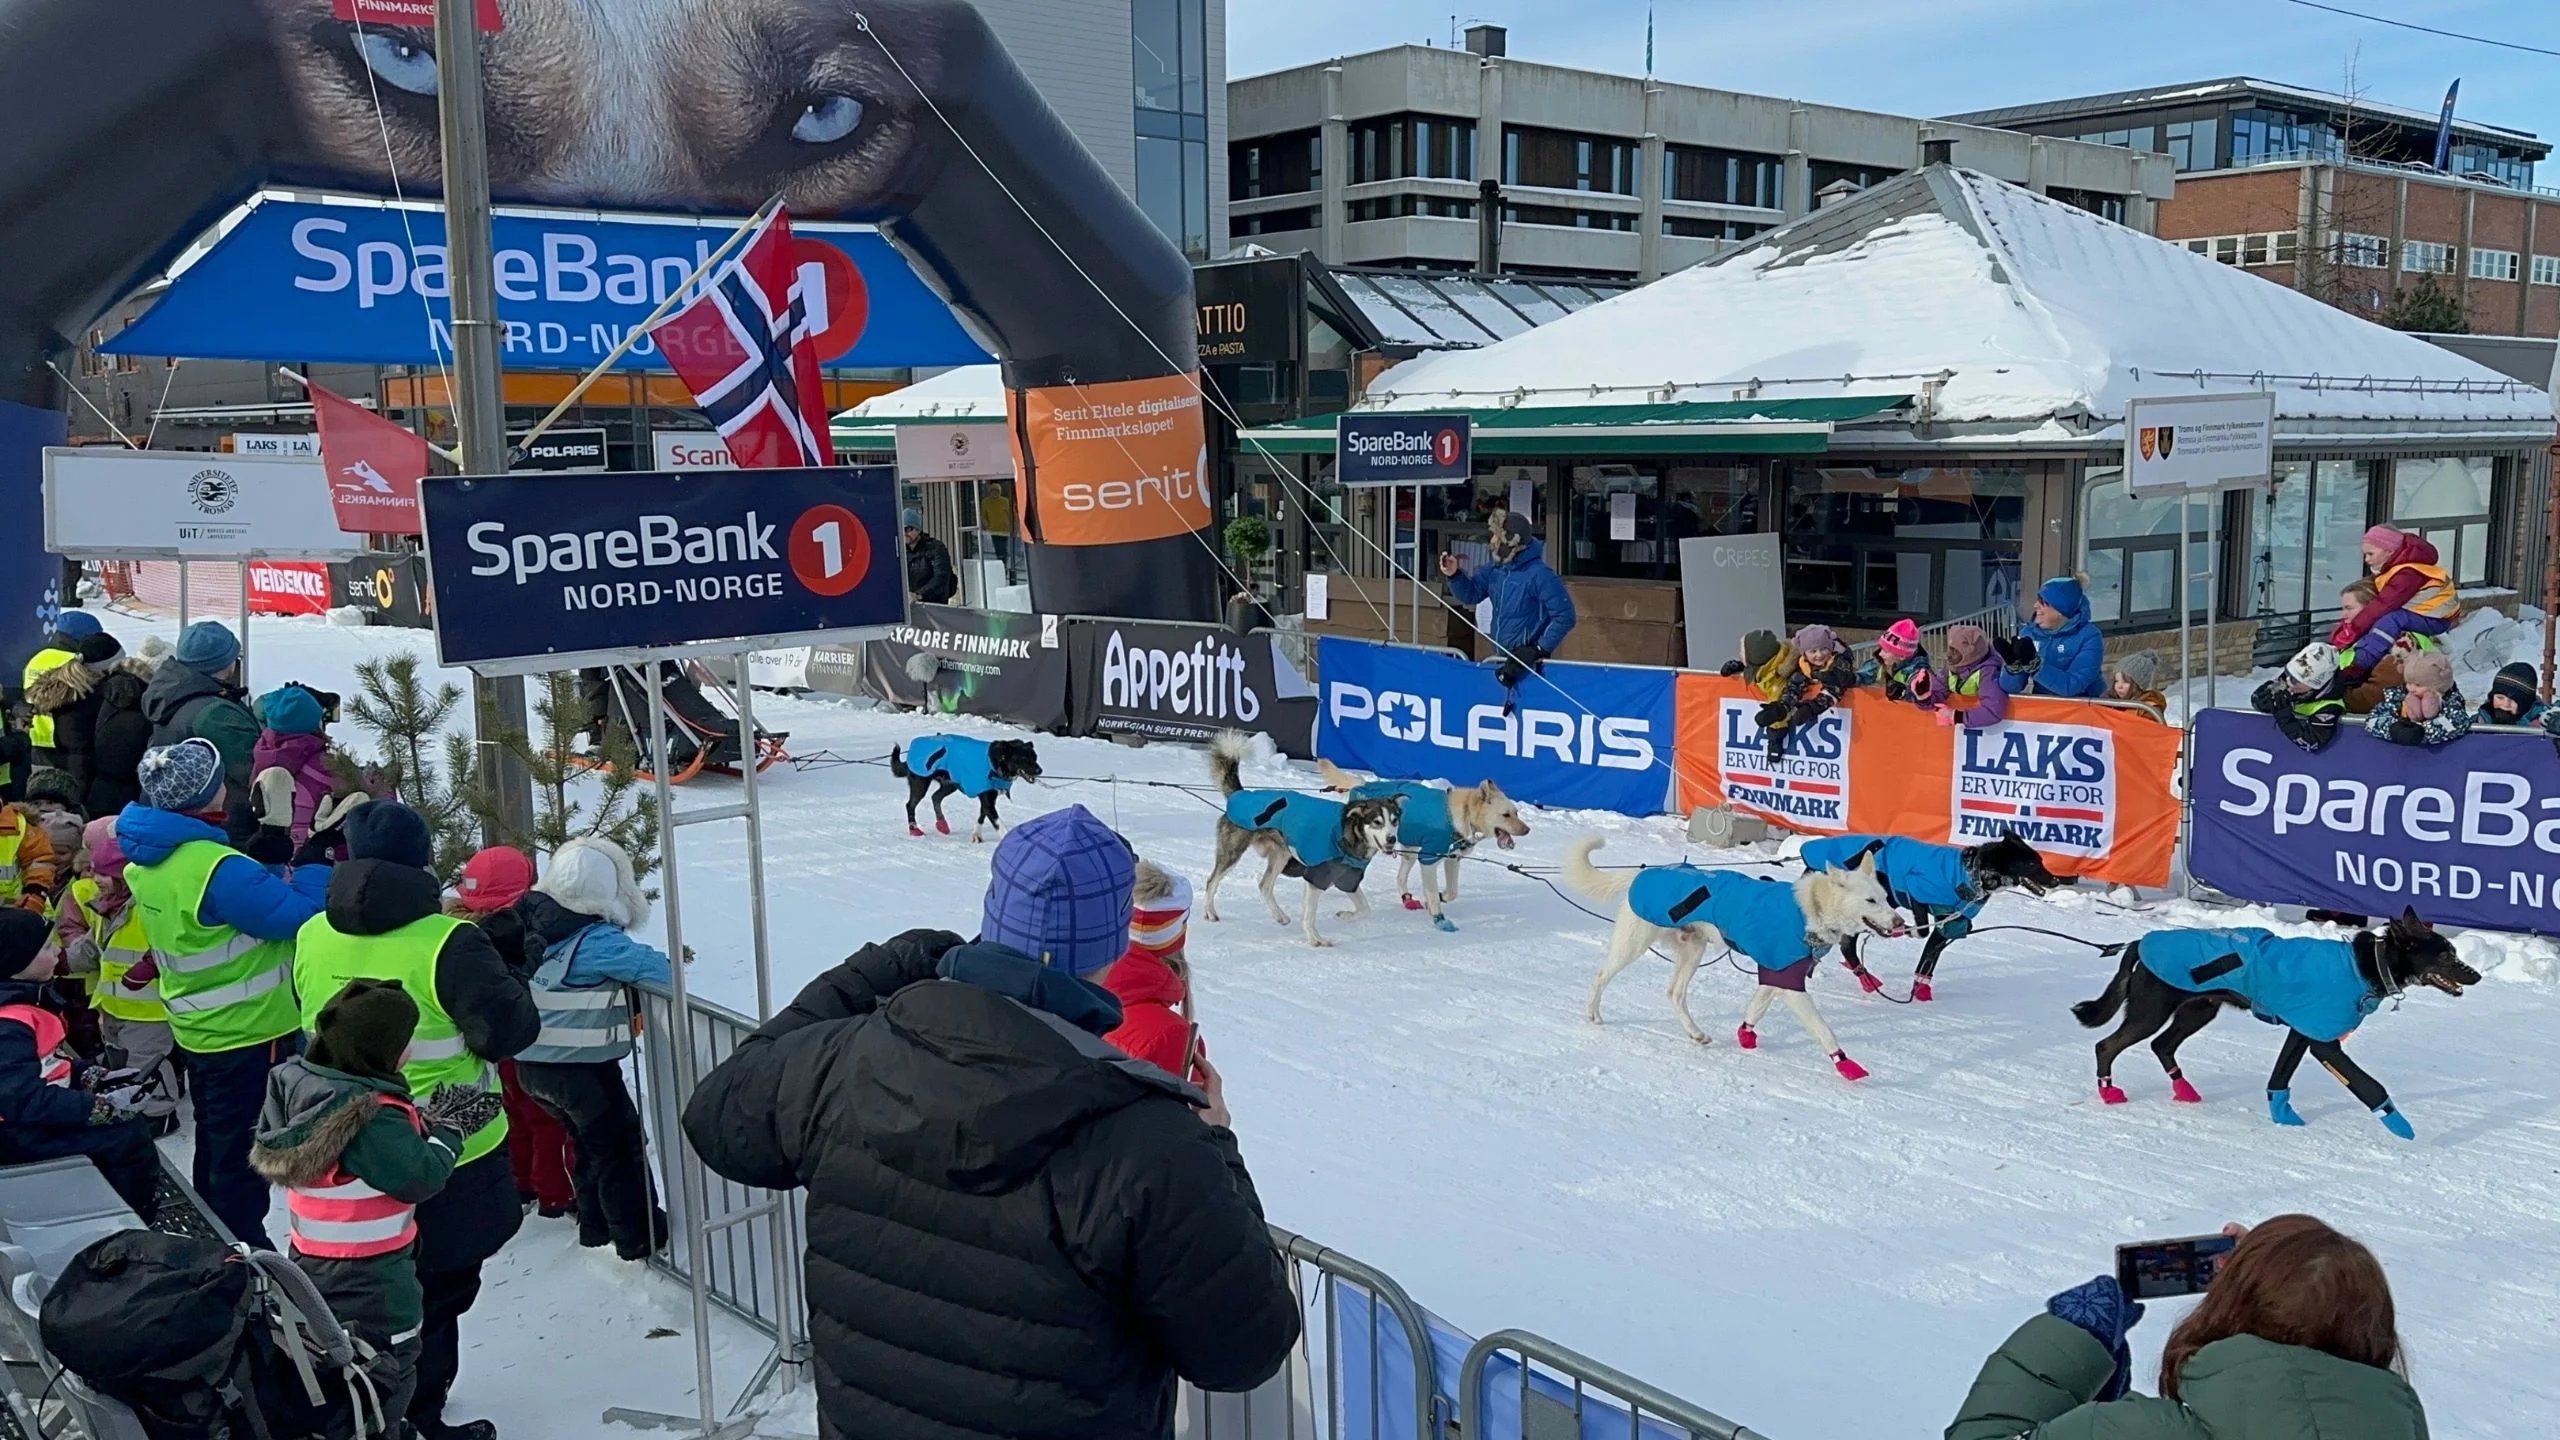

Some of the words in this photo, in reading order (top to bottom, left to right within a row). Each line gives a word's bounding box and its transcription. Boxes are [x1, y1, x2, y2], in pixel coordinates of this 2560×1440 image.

[291, 217, 739, 309] SpaeBank
[429, 317, 743, 356] NRD-NORGE
[1219, 341, 1246, 355] PASTA
[1054, 407, 1089, 422] Serit
[1091, 403, 1134, 419] Eltele
[1056, 416, 1175, 441] Finnmarksløpet!
[246, 440, 277, 450] LAKS
[531, 445, 600, 458] POLARIS
[1347, 430, 1432, 455] SpareBank
[1440, 434, 1453, 457] 1
[1370, 454, 1433, 467] NORD-NORGE
[187, 469, 239, 494] UNIVERSITETET
[1063, 465, 1193, 512] serit
[179, 528, 198, 539] UiT
[467, 510, 780, 586] SpareBank
[811, 520, 845, 580] 1
[250, 567, 326, 597] VEIDEKKE
[348, 575, 377, 598] serit
[563, 572, 784, 611] NORD-NORGE
[749, 651, 764, 664] alle
[766, 657, 782, 666] over
[784, 654, 794, 667] 19
[953, 633, 1031, 659] FINNMARK
[1103, 629, 1261, 723] Appetitt
[1098, 717, 1154, 733] NORWEGIAN
[1154, 724, 1182, 736] SUPER
[1329, 680, 1655, 771] POLARIS
[1725, 751, 1747, 769] ER
[1807, 760, 1841, 780] FOR
[1961, 728, 2106, 784] LAKS
[1727, 783, 1841, 820] FINNMARK
[1960, 775, 1988, 796] ER
[1990, 778, 2056, 801] VIKTIG
[2059, 784, 2105, 806] FOR
[1958, 813, 2104, 849] FINNMARK
[2335, 849, 2560, 909] NORD-N
